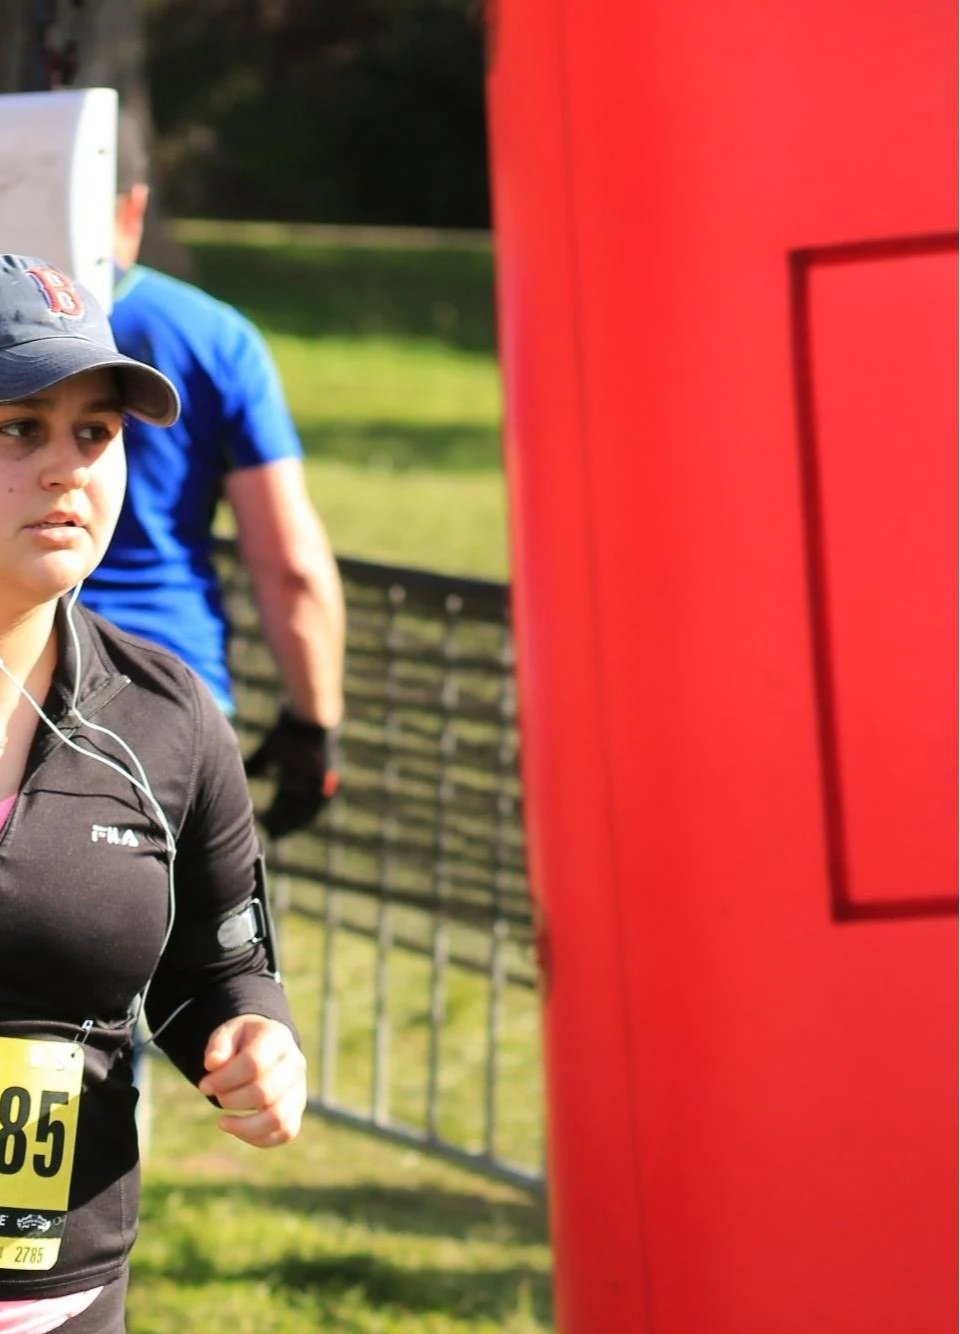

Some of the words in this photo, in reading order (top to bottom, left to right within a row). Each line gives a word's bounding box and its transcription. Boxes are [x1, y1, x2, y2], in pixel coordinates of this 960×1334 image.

[27, 268, 83, 317] B
[91, 824, 139, 847] FILA
[14, 1246, 44, 1264] 2785
